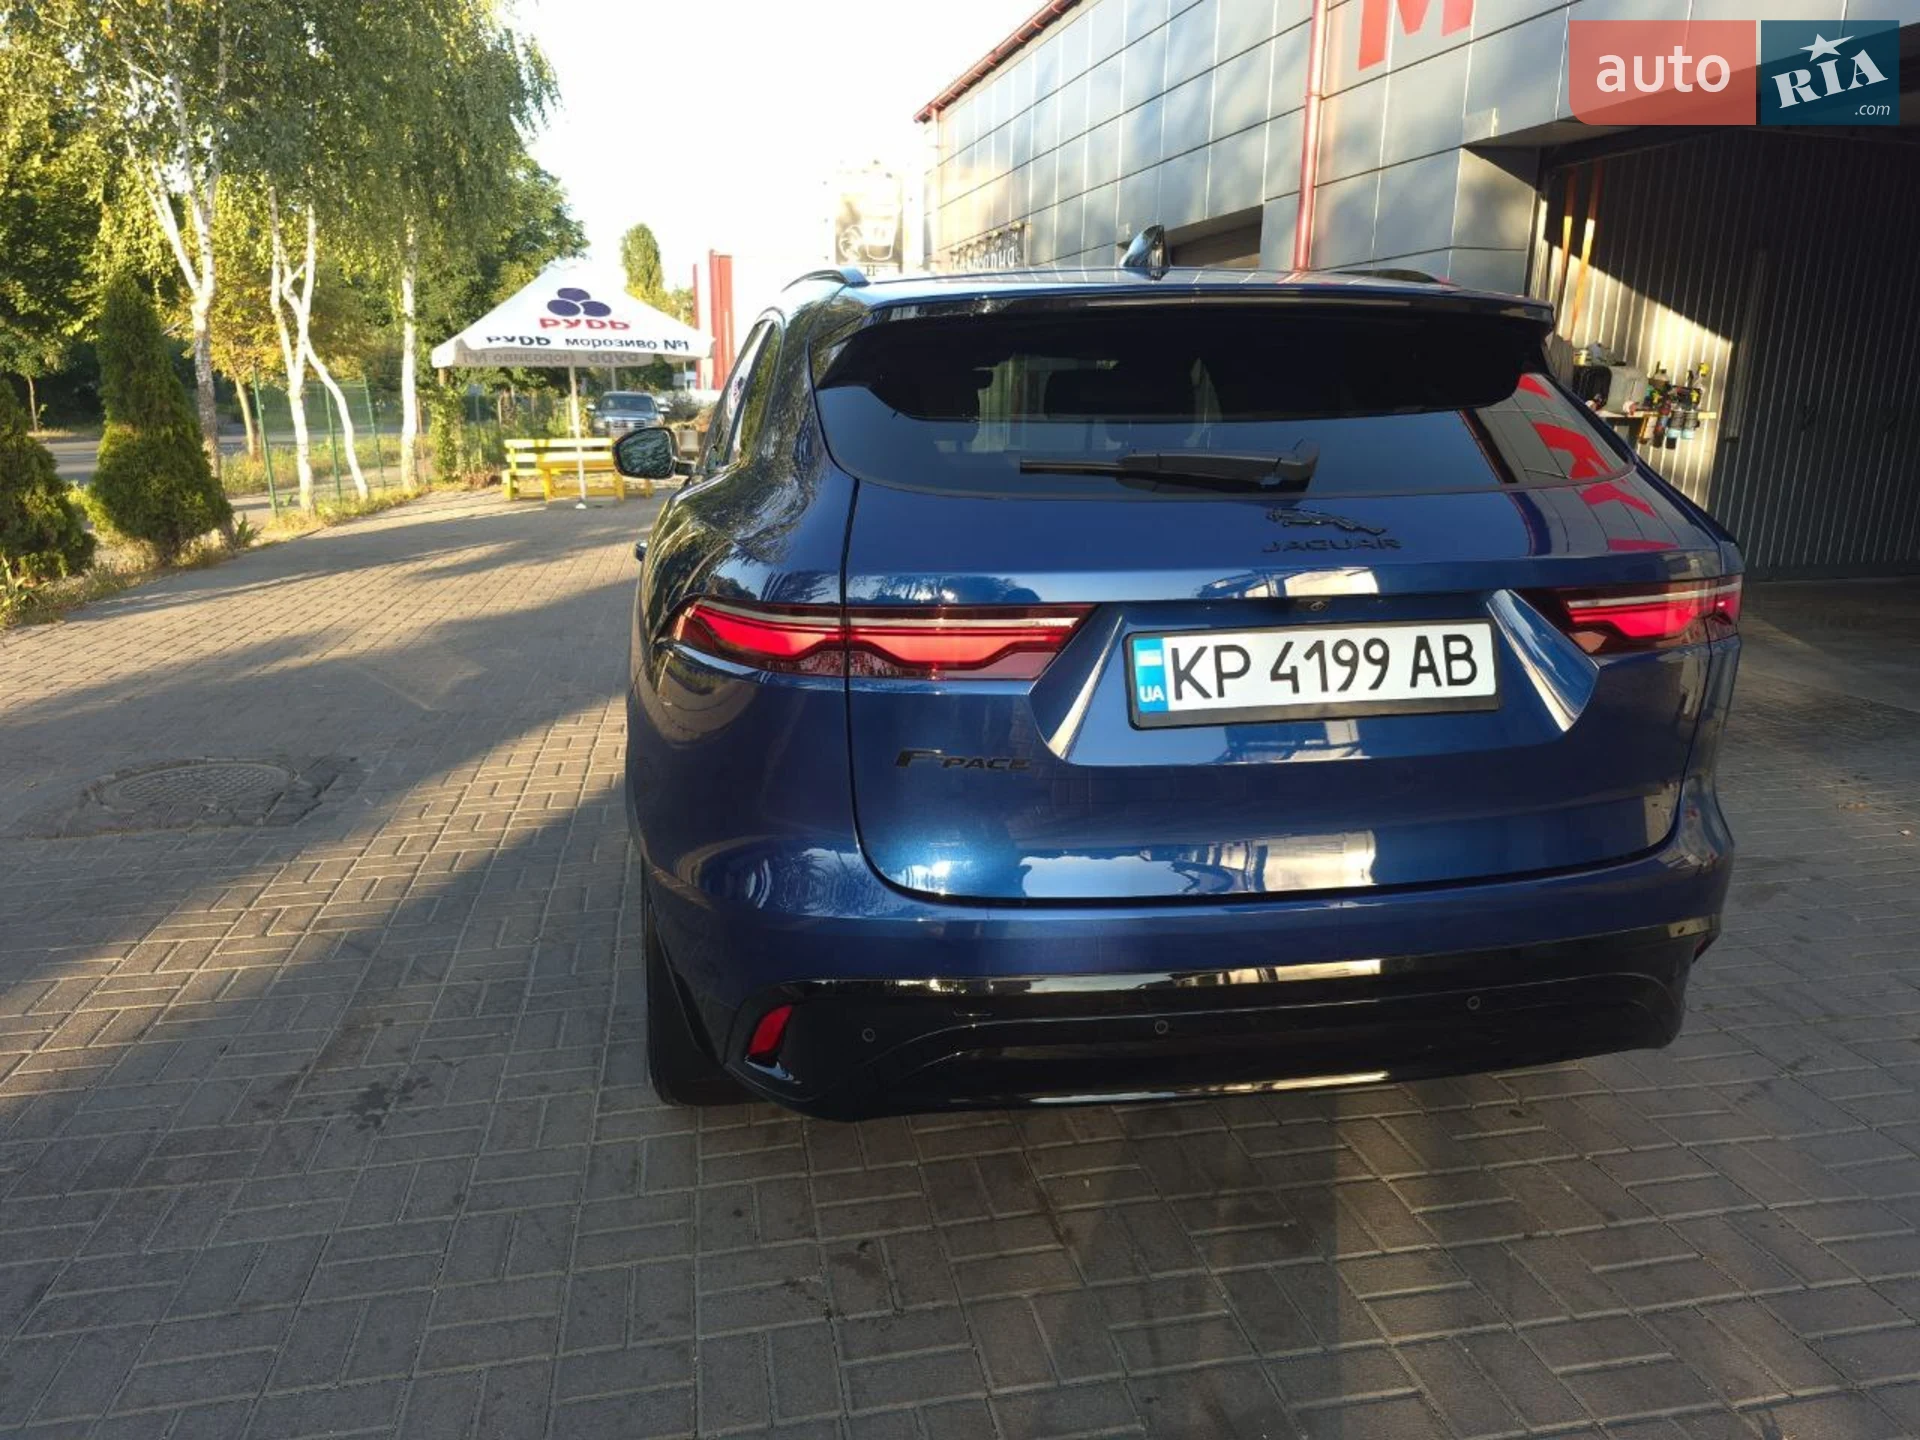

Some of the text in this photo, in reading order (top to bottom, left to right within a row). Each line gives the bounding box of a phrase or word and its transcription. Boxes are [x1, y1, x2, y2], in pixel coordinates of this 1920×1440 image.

[1261, 538, 1402, 553] JAGUAR
[1171, 634, 1479, 701] KP 4199 AB
[1140, 686, 1165, 703] UA
